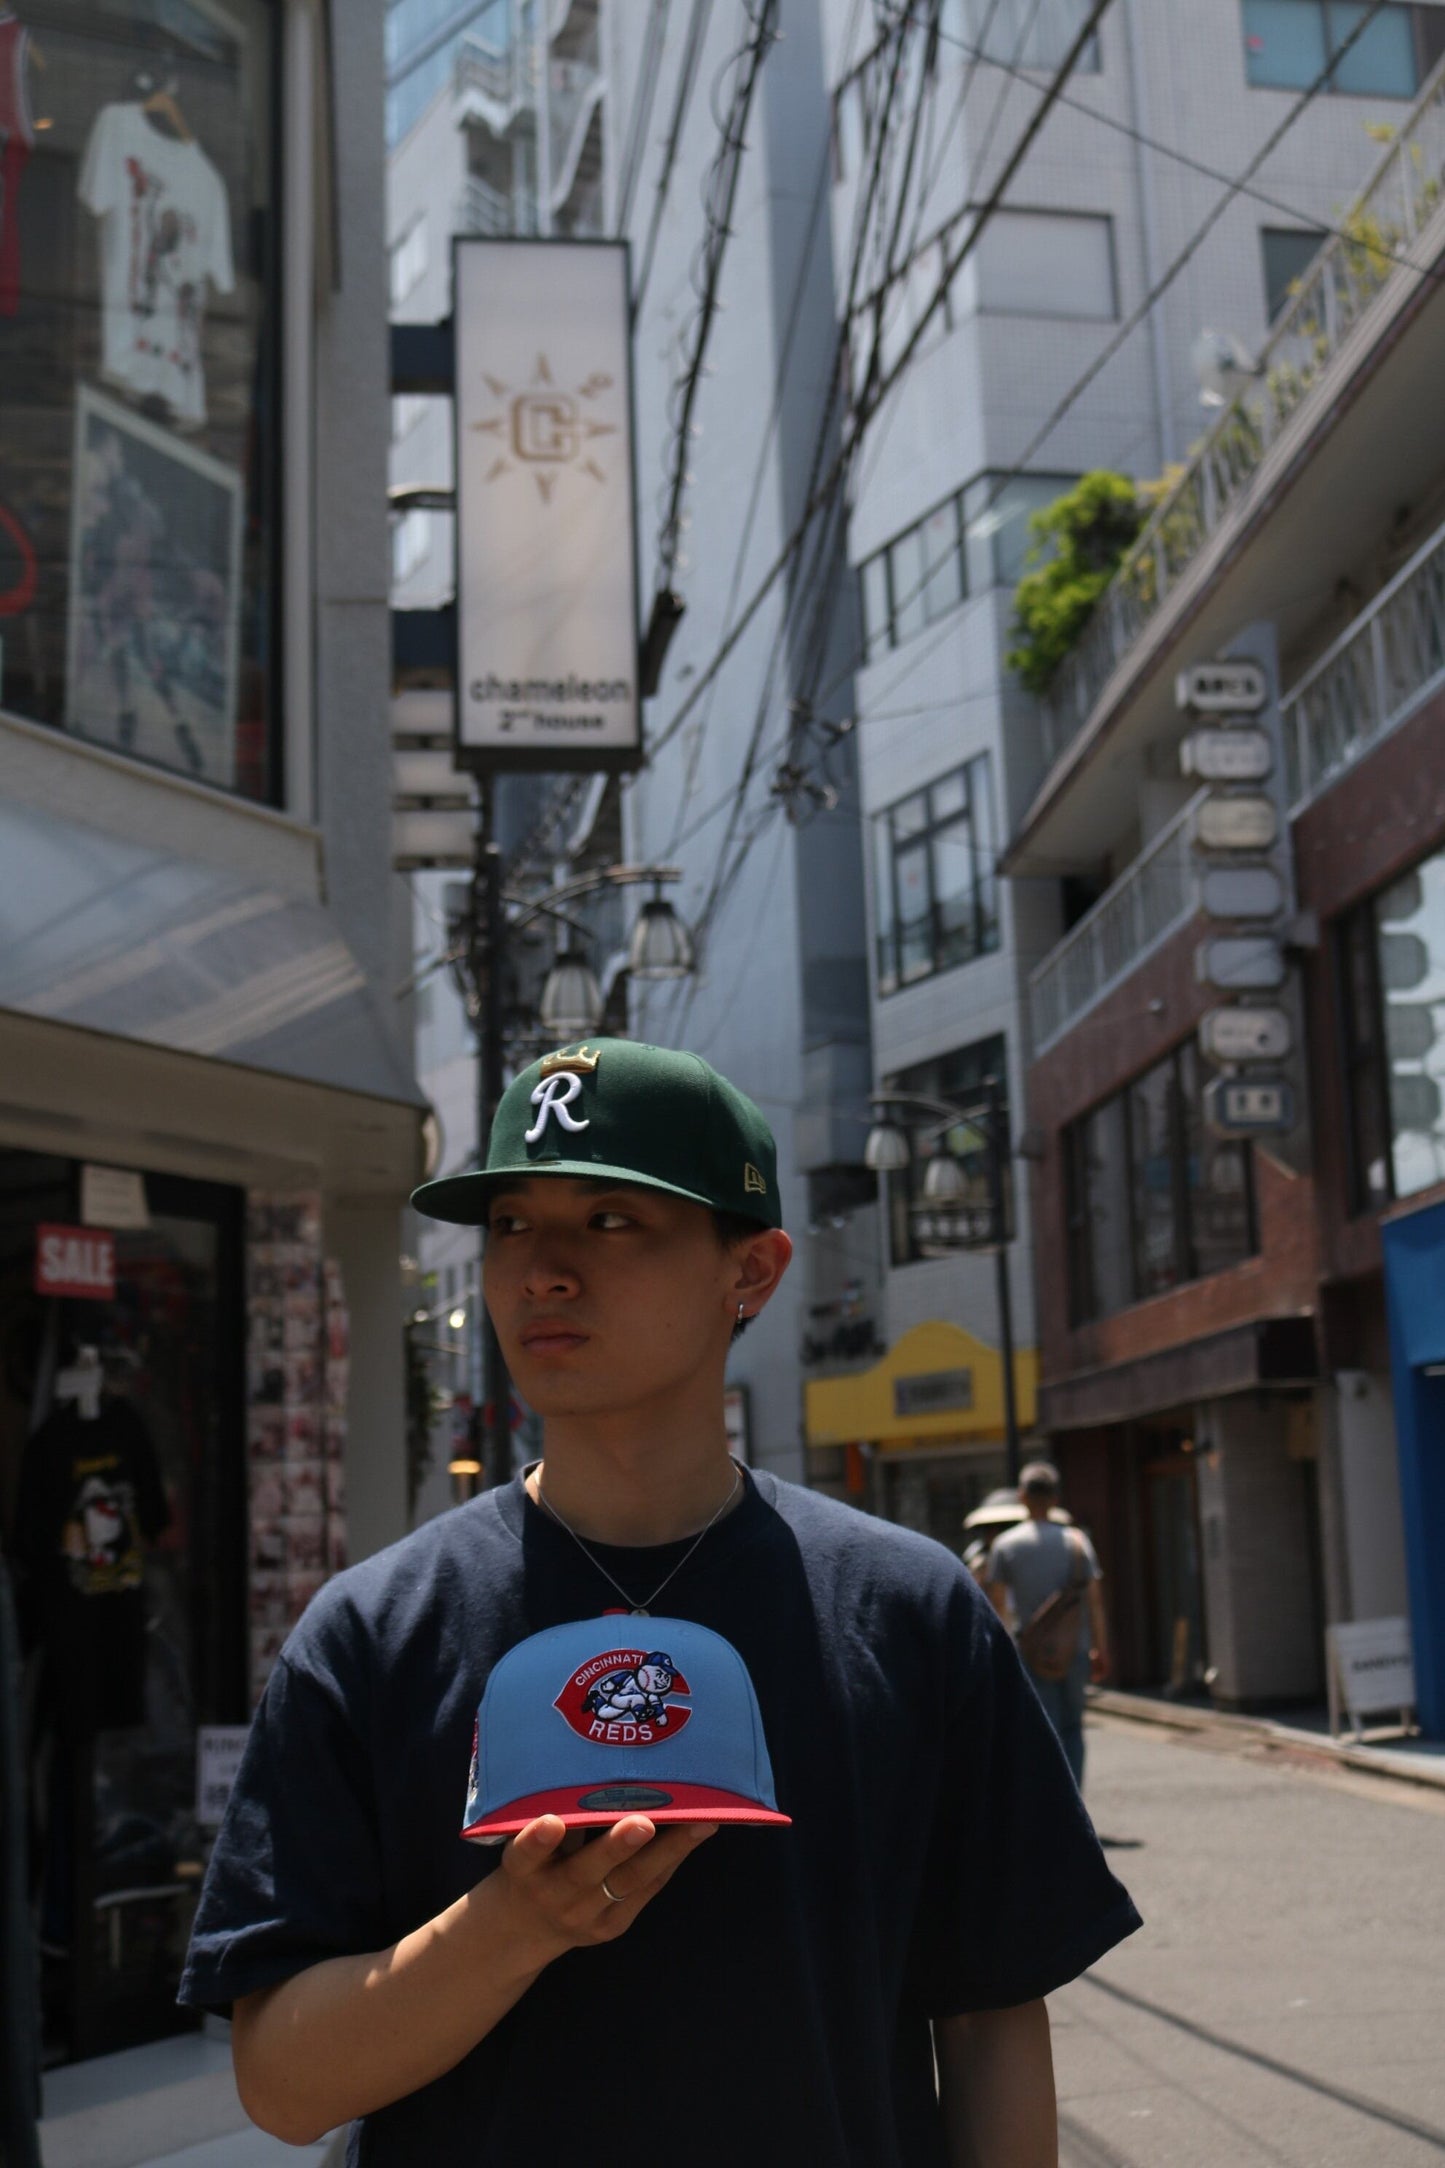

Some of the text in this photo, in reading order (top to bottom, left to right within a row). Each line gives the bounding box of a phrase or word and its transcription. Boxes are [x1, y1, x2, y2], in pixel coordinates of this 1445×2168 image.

[470, 671, 629, 702] chameleon
[533, 712, 606, 731] house
[525, 1071, 590, 1143] R
[43, 1236, 115, 1287] SALE
[575, 1653, 643, 1687] CINCINNATI
[588, 1720, 653, 1742] REDS
